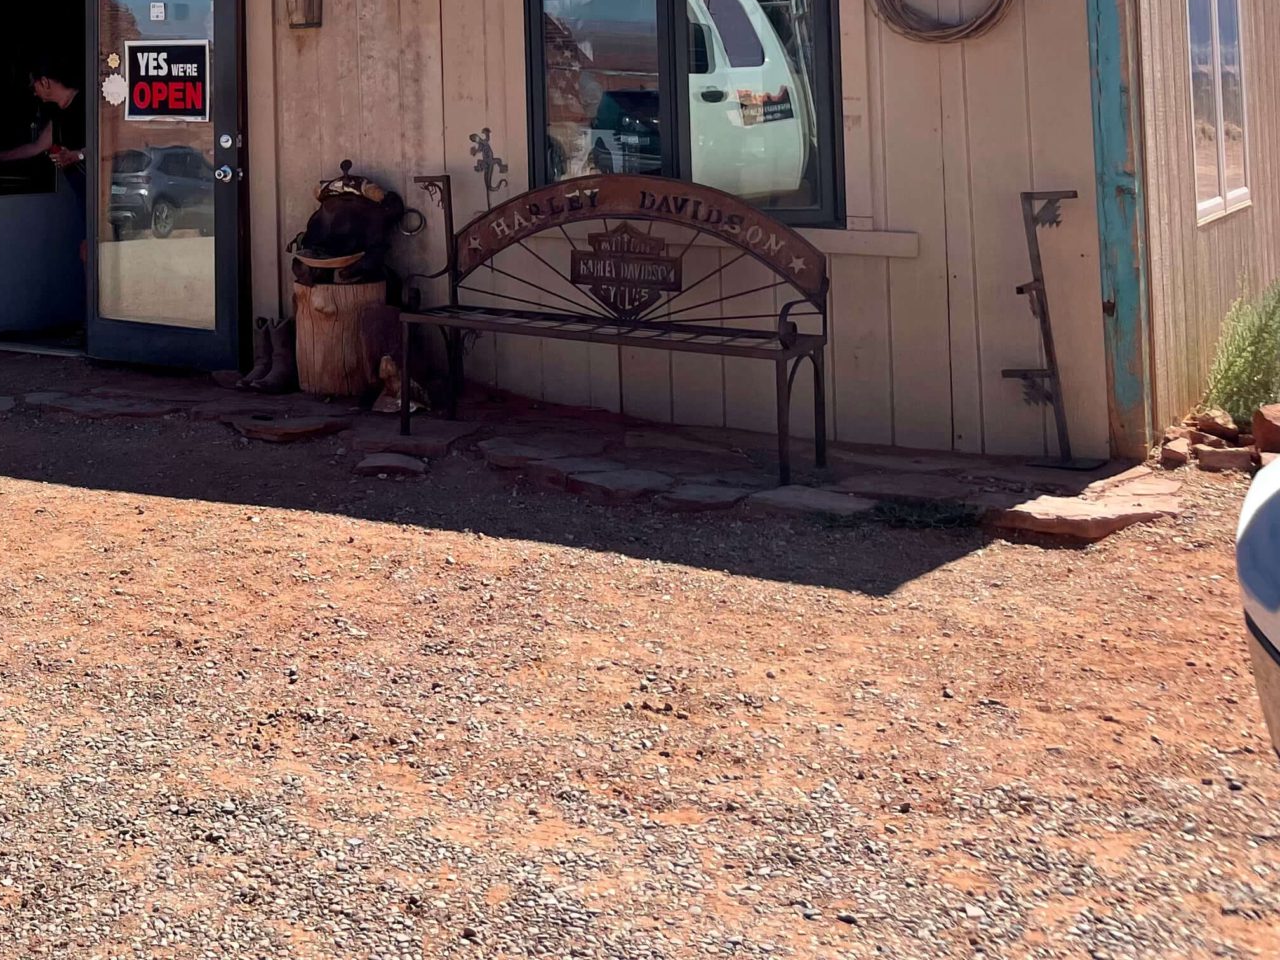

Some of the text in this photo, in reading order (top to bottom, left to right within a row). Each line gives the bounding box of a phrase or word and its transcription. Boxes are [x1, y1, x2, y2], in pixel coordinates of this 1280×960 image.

[137, 52, 198, 76] YES WE'RE
[133, 82, 202, 109] OPEN
[491, 188, 786, 259] HARLEY DAVIDSON
